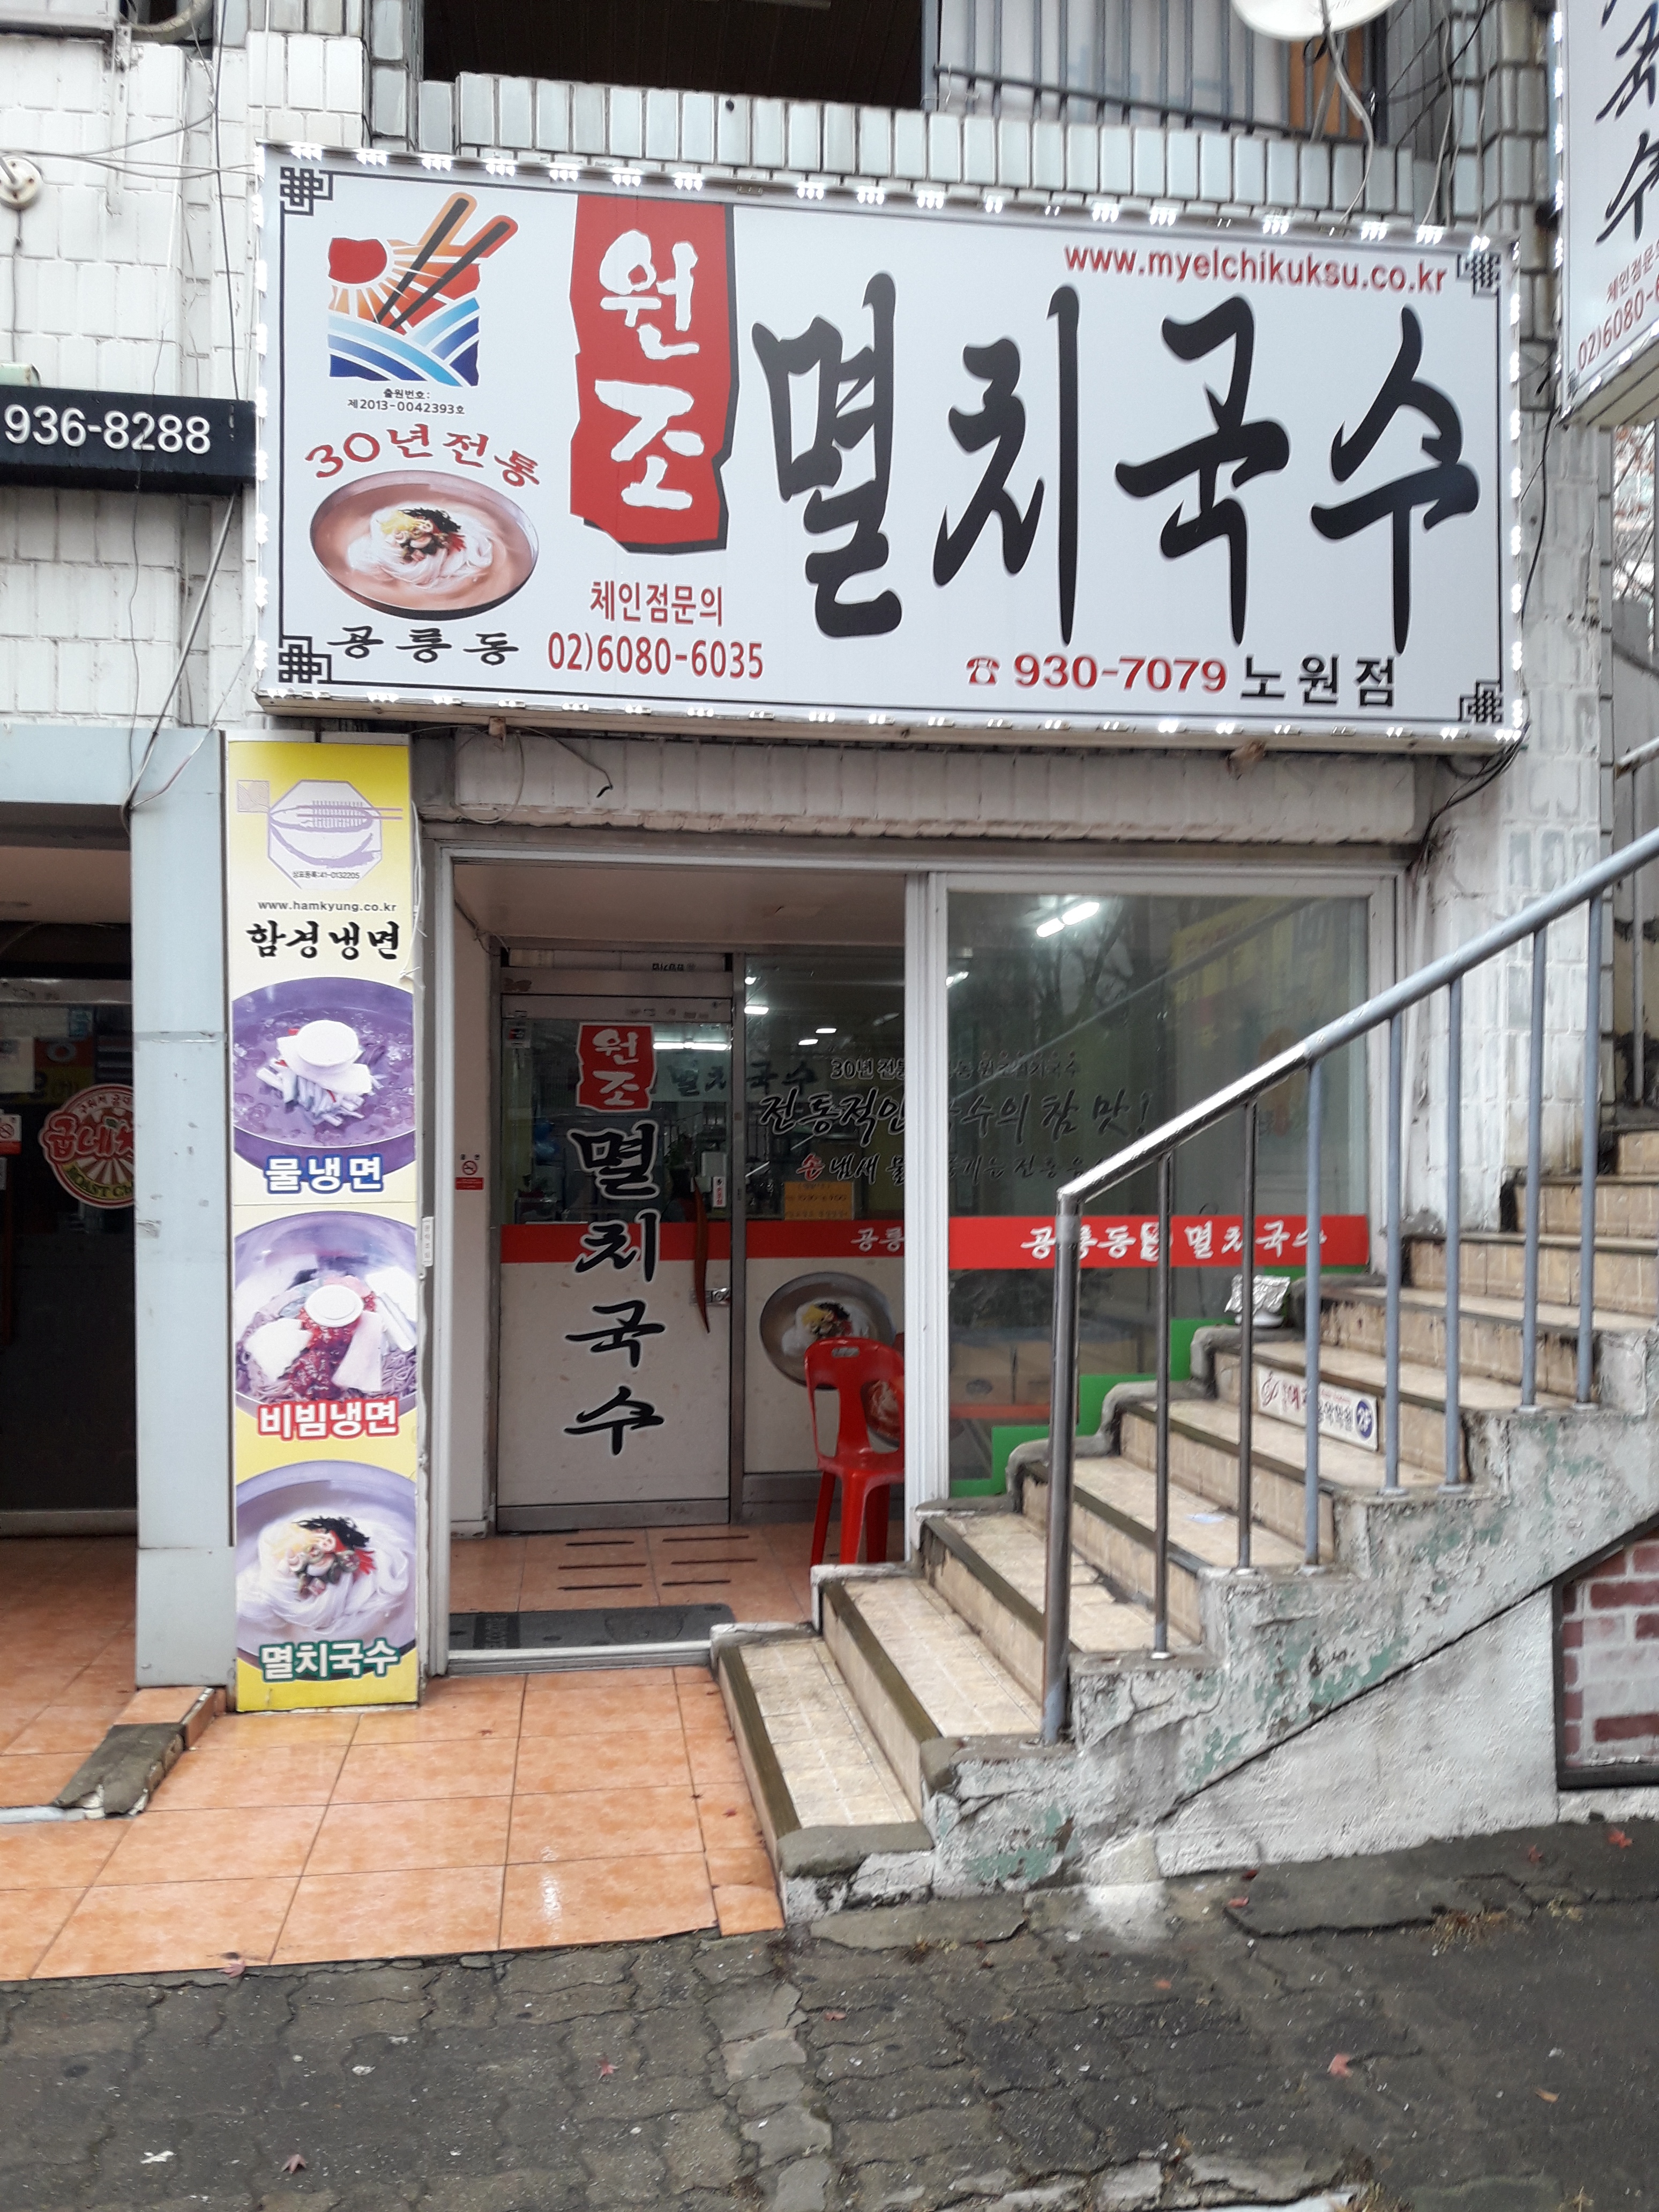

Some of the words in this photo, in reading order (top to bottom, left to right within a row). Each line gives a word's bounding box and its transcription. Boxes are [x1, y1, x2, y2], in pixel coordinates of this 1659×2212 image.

[1595, 0, 1659, 244] 국수
[1064, 244, 1446, 294] www.myelchikuksu.co.kr
[1578, 273, 1659, 370] 02)6080-
[595, 229, 705, 510] 원조
[4, 403, 211, 454] 936-8288
[752, 271, 1480, 654] 멸치국수
[589, 580, 723, 627] 체인점문의
[548, 631, 764, 679] 02)6080-6035
[1013, 653, 1227, 692] 930-7079
[1240, 654, 1395, 705] 노원점
[246, 920, 400, 960] 함경냉면
[592, 1028, 640, 1107] 원조
[265, 1155, 384, 1194] 물냉면
[564, 1121, 666, 1456] 멸치국수
[258, 1398, 399, 1441] 비빔냉면
[259, 1638, 400, 1683] 멸치국수
